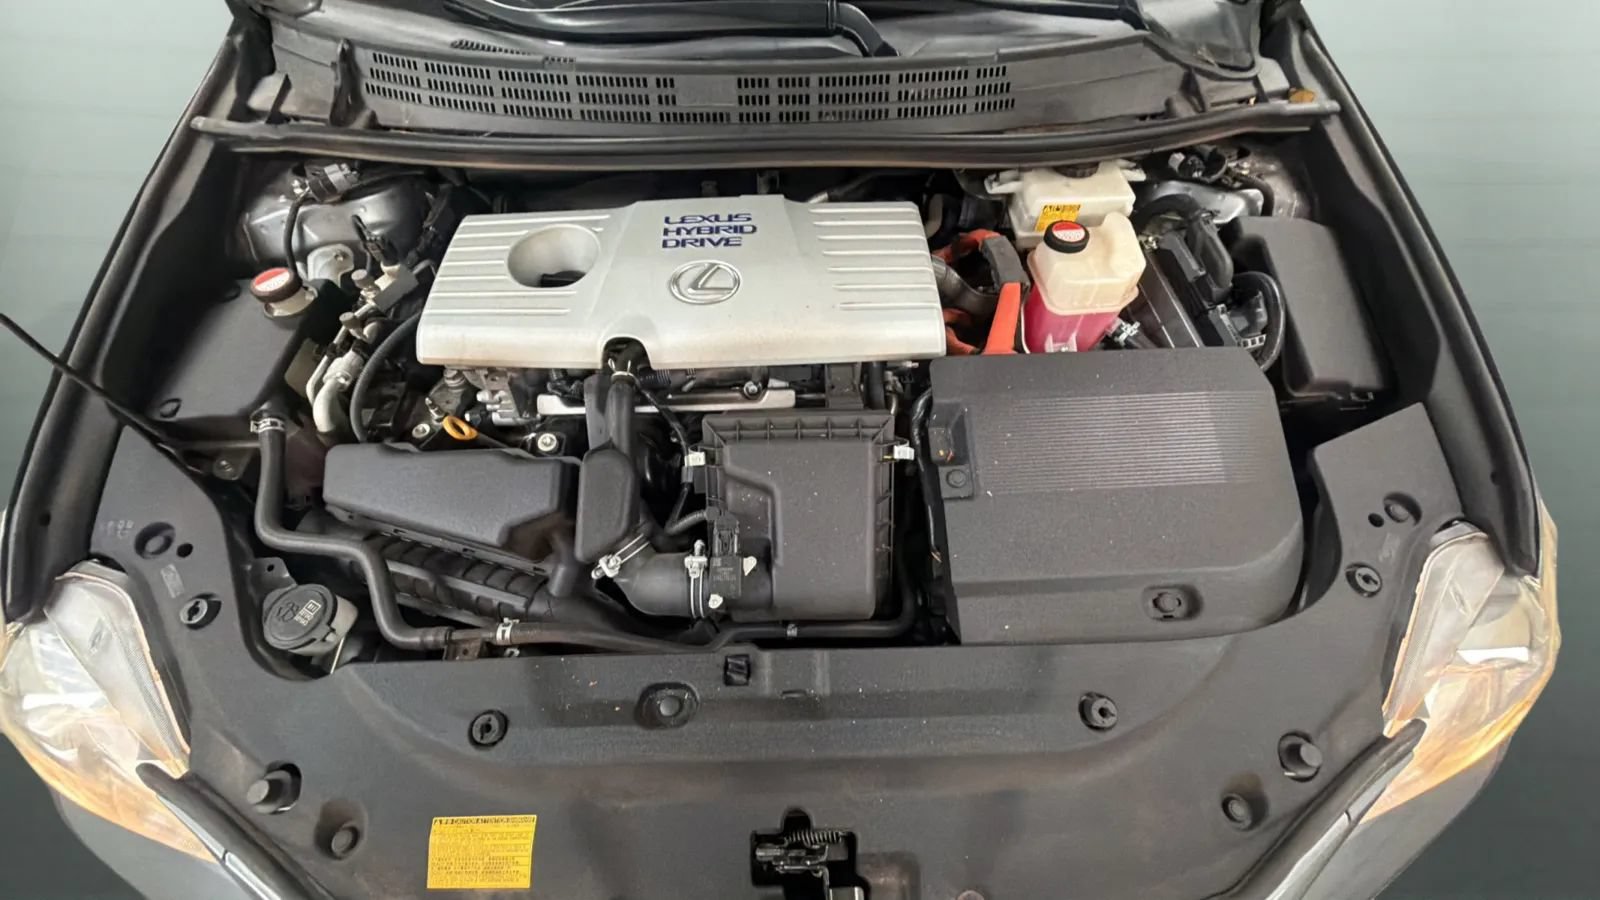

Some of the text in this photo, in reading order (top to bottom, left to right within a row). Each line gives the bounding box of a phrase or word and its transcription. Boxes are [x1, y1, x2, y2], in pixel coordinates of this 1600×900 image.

[664, 213, 753, 224] LEXUS
[663, 224, 757, 236] HYBRID
[662, 236, 742, 248] DRIVE
